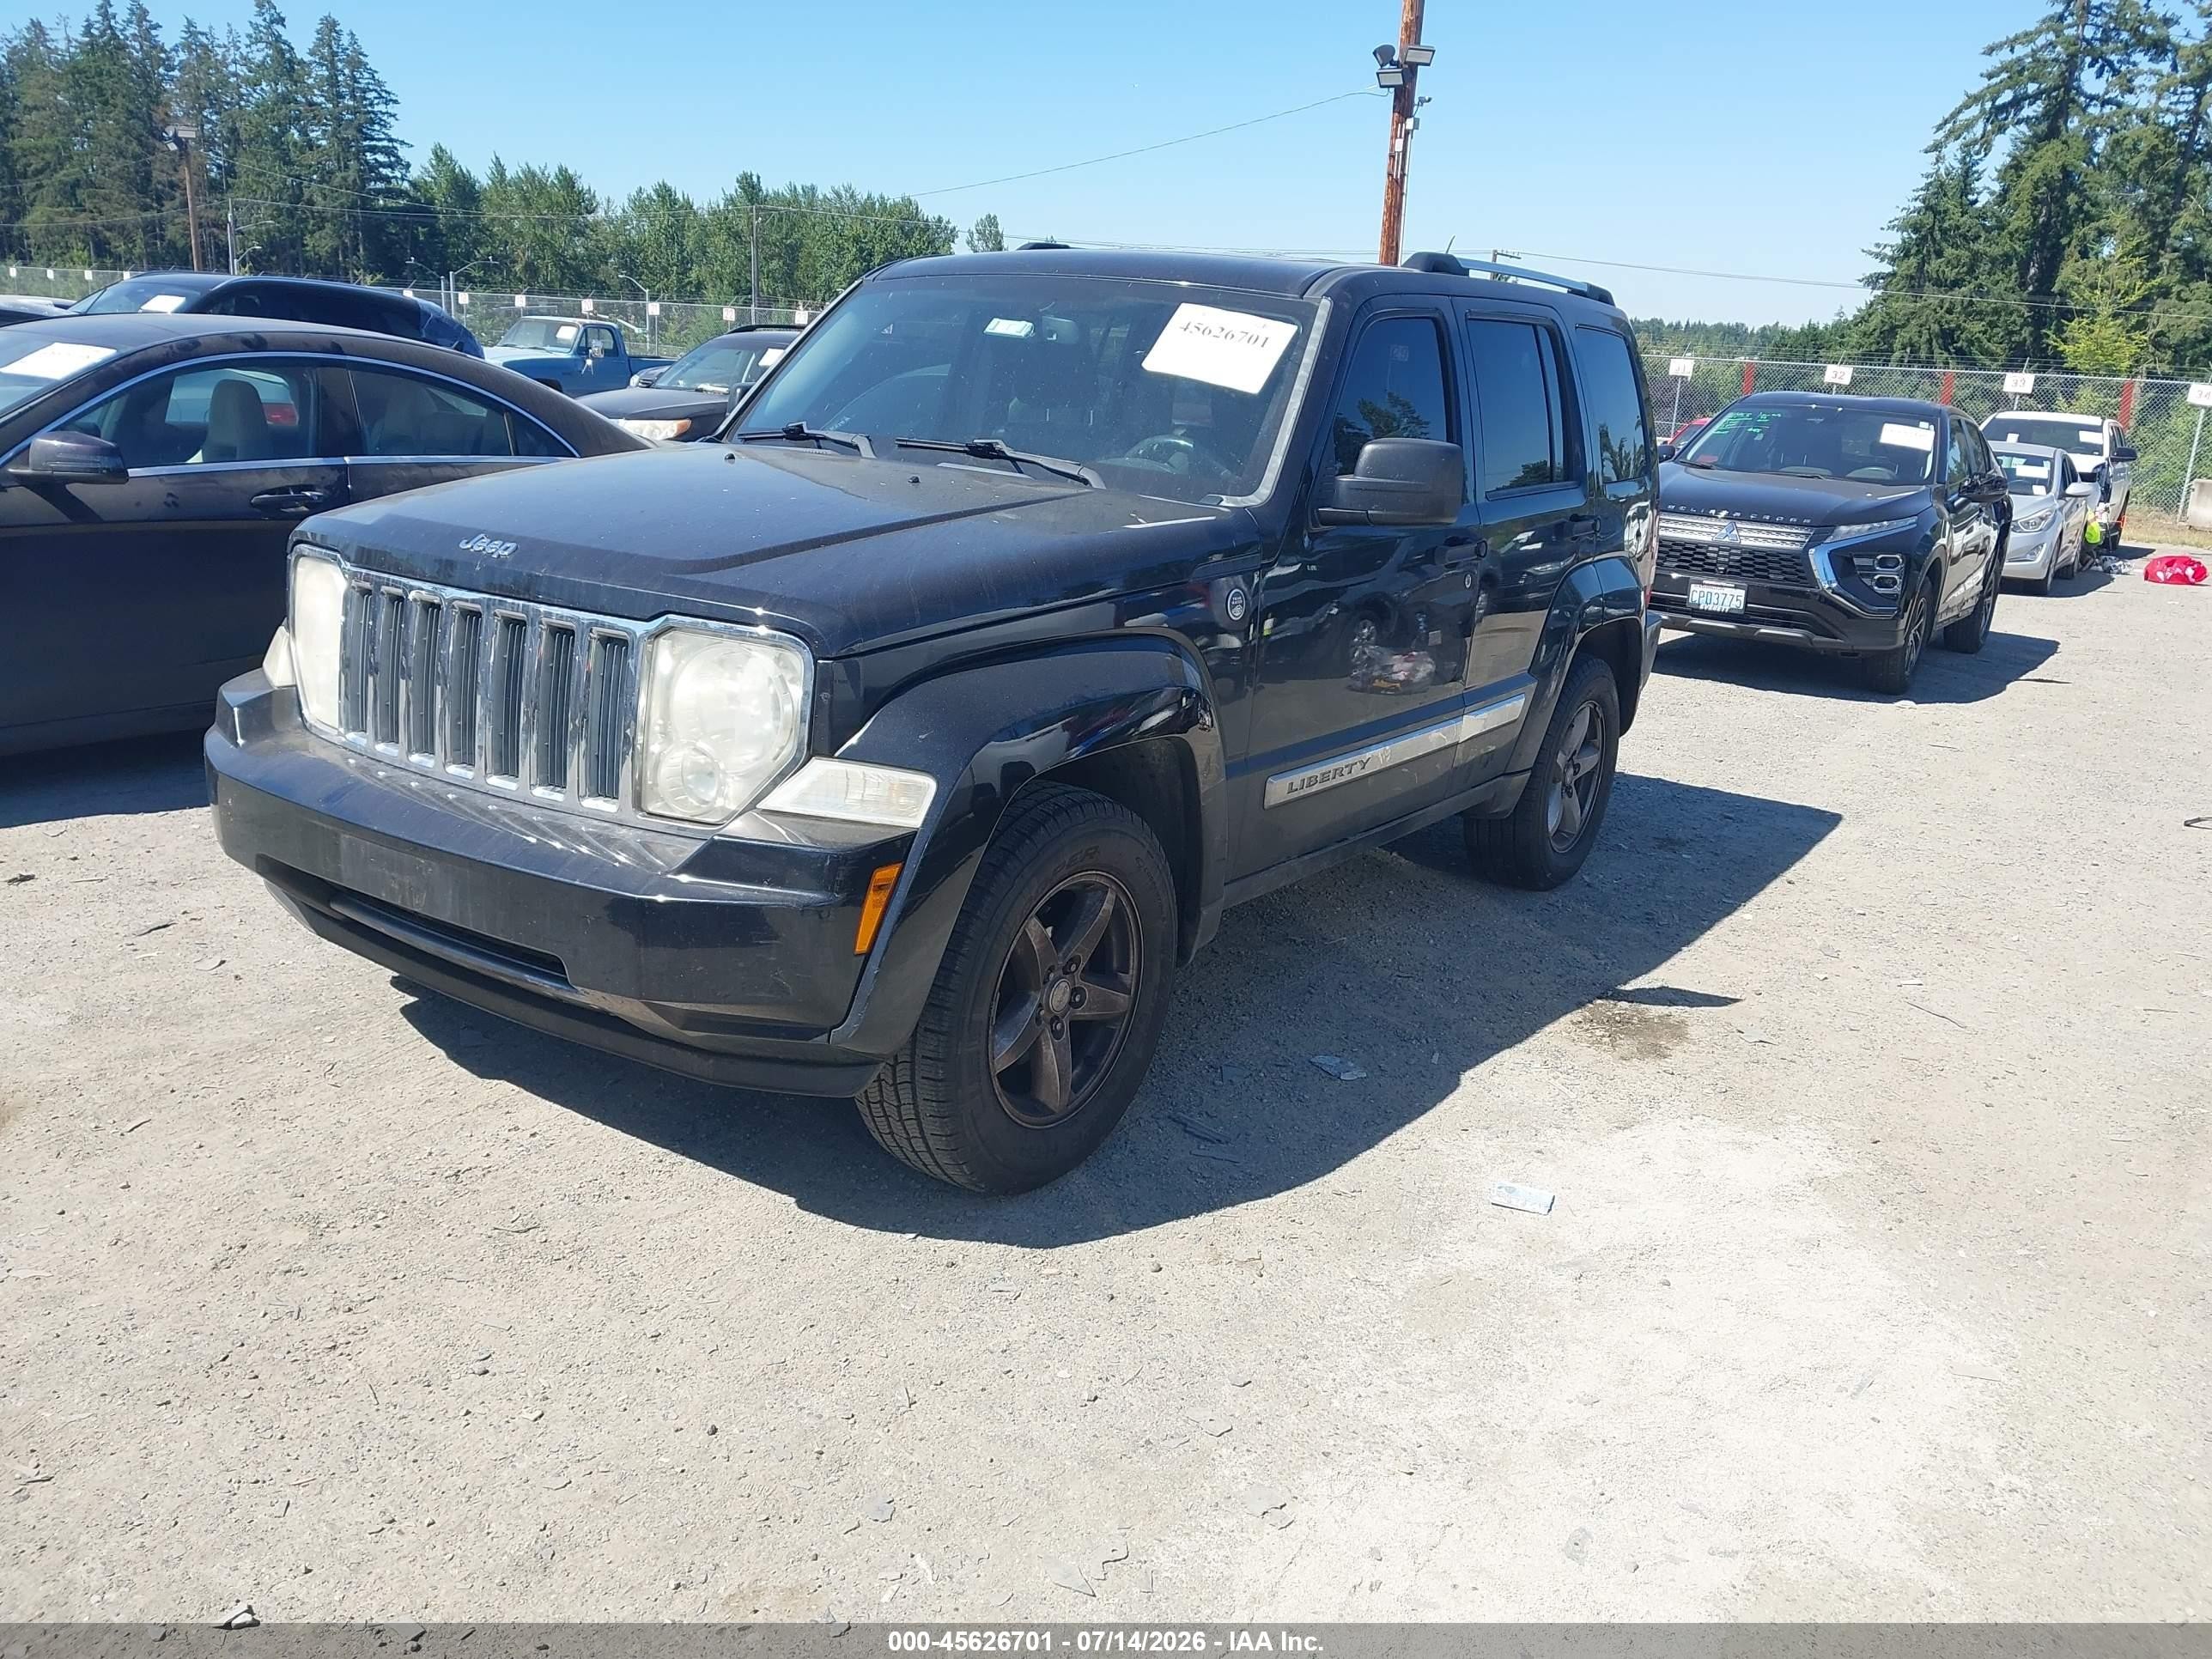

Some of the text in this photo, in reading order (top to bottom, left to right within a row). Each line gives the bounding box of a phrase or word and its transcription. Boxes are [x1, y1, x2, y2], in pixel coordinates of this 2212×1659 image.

[1180, 321, 1270, 348] 45626701
[1832, 370, 1845, 380] 32
[2011, 378, 2026, 388] 33
[459, 533, 518, 558] Jeep
[1691, 590, 1743, 609] CPD3775
[1286, 757, 1371, 794] LIBERTY
